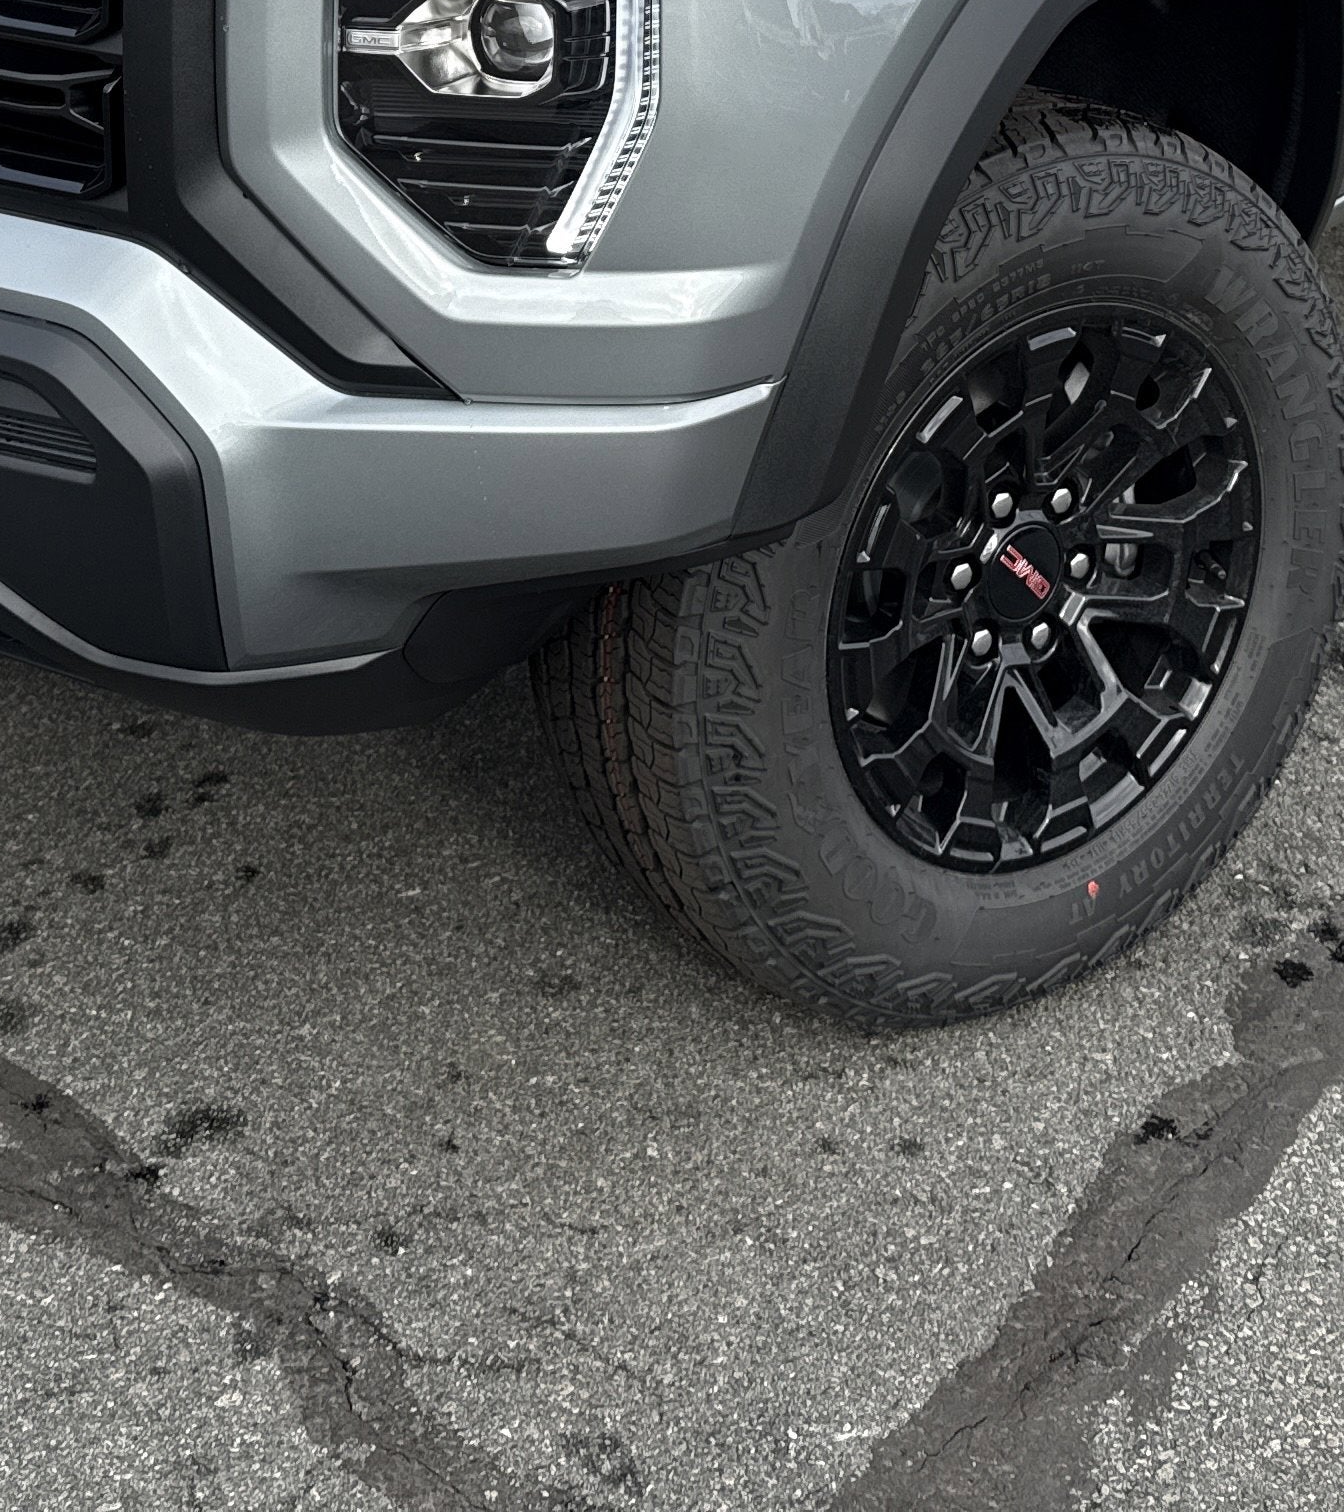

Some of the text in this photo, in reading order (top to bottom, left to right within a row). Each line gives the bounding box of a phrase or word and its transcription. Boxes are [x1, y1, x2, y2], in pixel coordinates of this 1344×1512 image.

[1204, 265, 1329, 596] WRANGLER
[999, 543, 1051, 600] GMC
[1118, 752, 1246, 899] TERRITORY
[1068, 895, 1097, 926] AT
